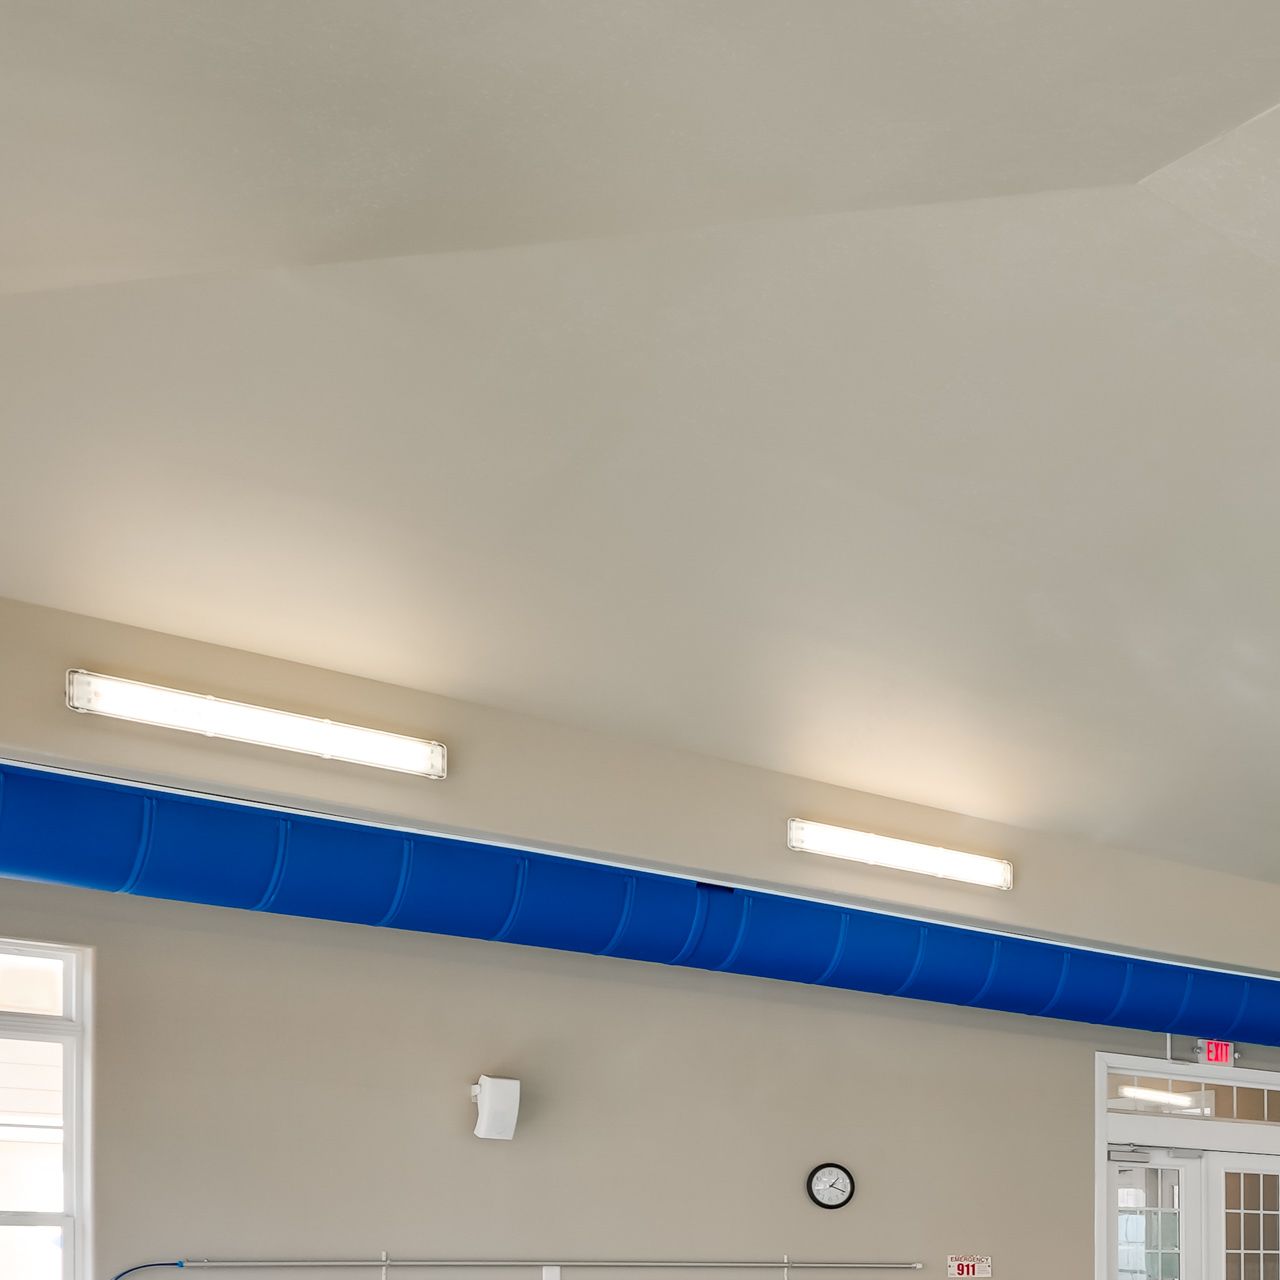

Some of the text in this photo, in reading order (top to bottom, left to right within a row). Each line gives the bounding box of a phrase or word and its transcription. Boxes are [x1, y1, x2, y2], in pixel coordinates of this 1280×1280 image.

[1206, 1041, 1230, 1063] EXIT
[950, 1255, 989, 1263] EMERGENCY
[957, 1263, 976, 1276] 911
